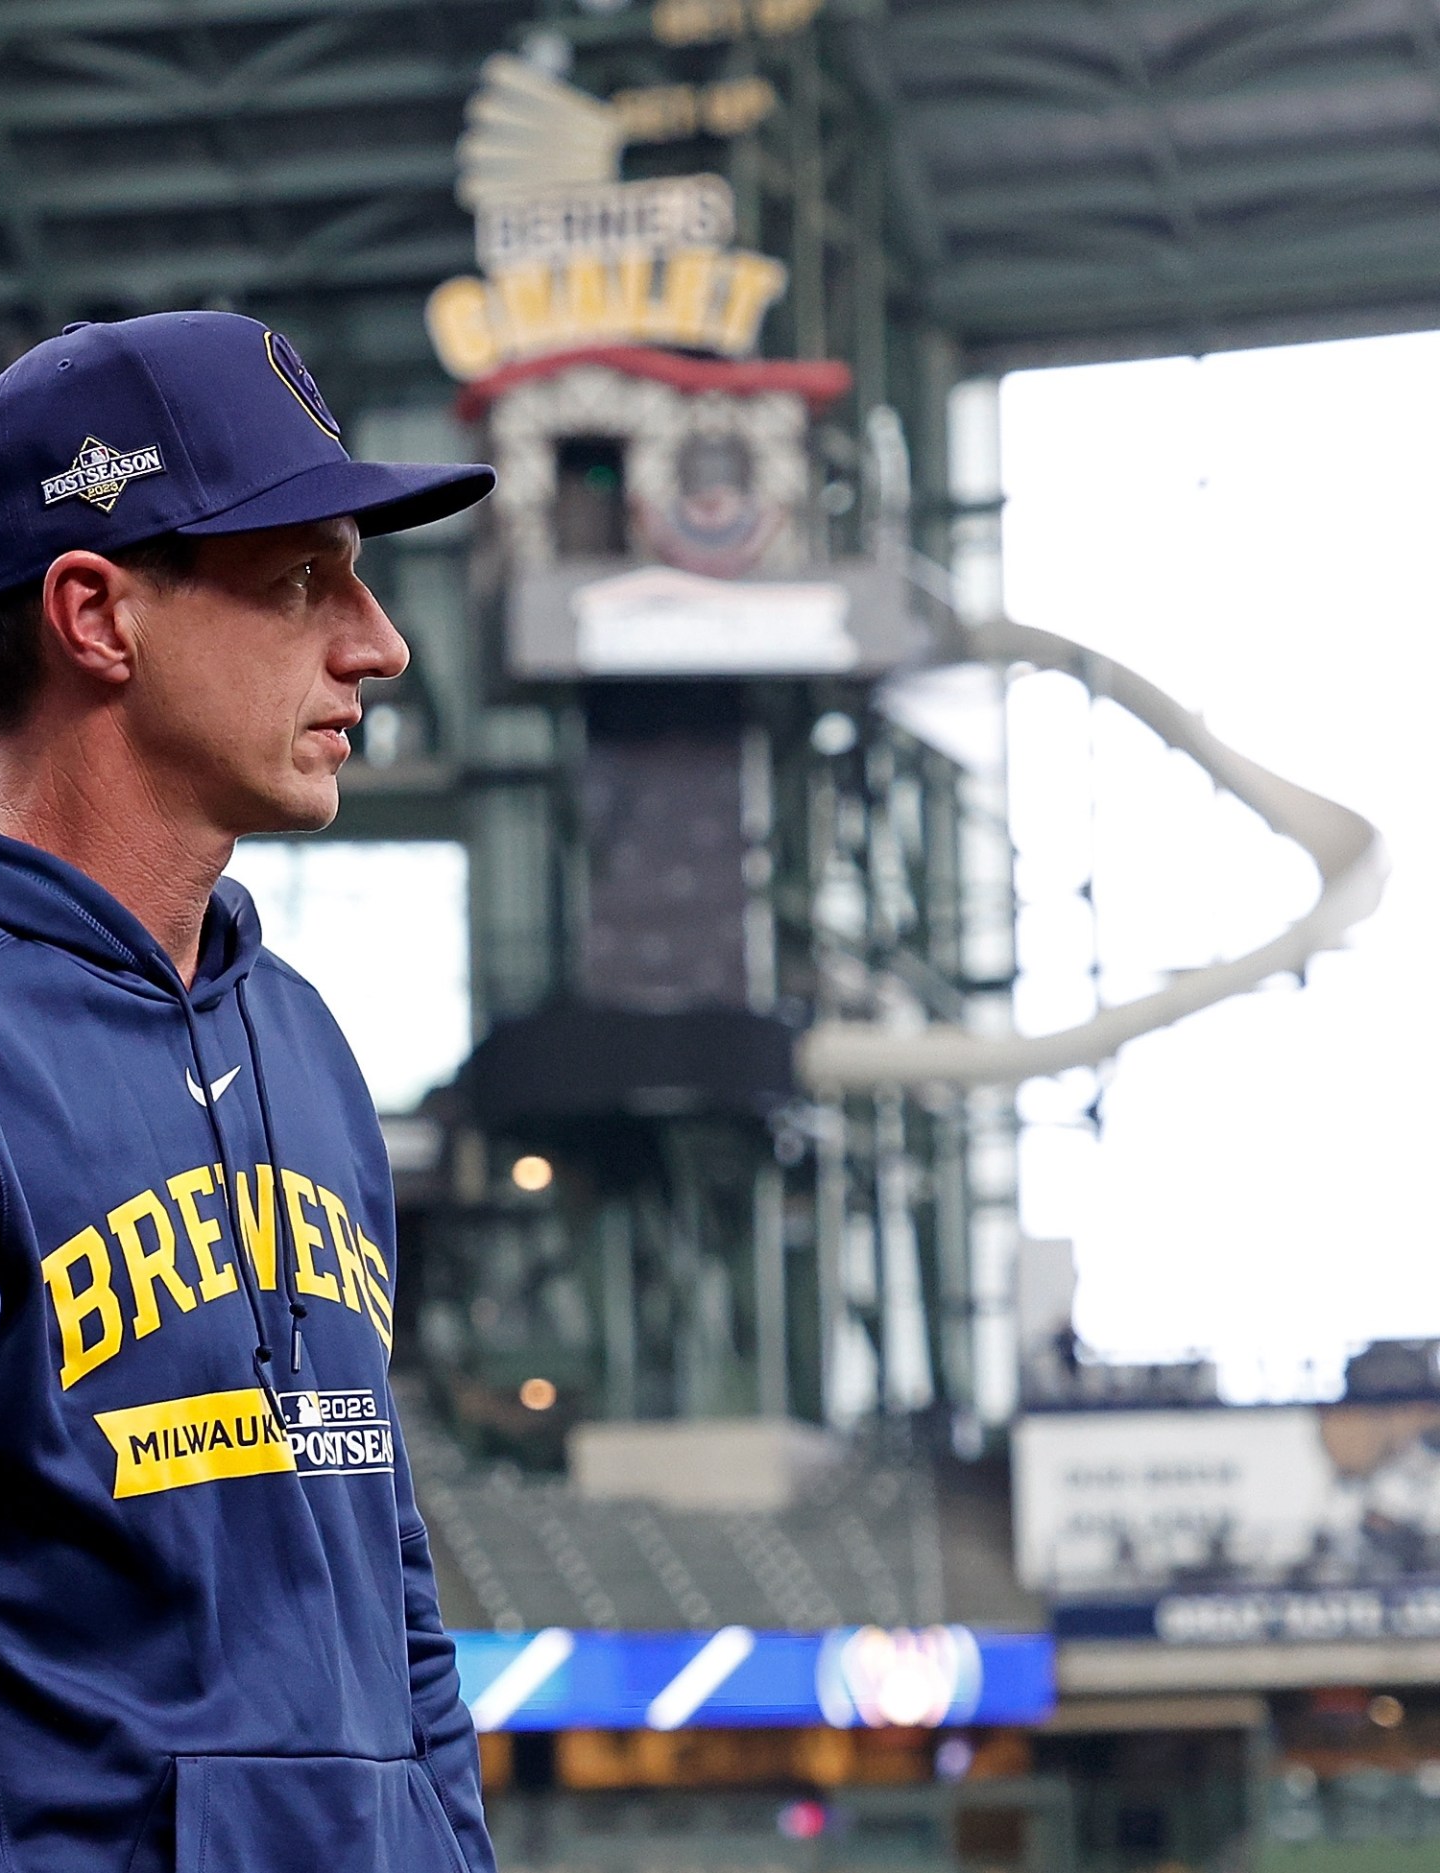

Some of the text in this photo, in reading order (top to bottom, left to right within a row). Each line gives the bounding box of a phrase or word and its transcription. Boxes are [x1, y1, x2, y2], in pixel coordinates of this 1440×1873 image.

[42, 449, 161, 501] POSTSEASON
[87, 481, 119, 498] 2023
[41, 1163, 393, 1391] BREWERS
[320, 1397, 377, 1419] 2023
[128, 1413, 288, 1465] MILWAUK
